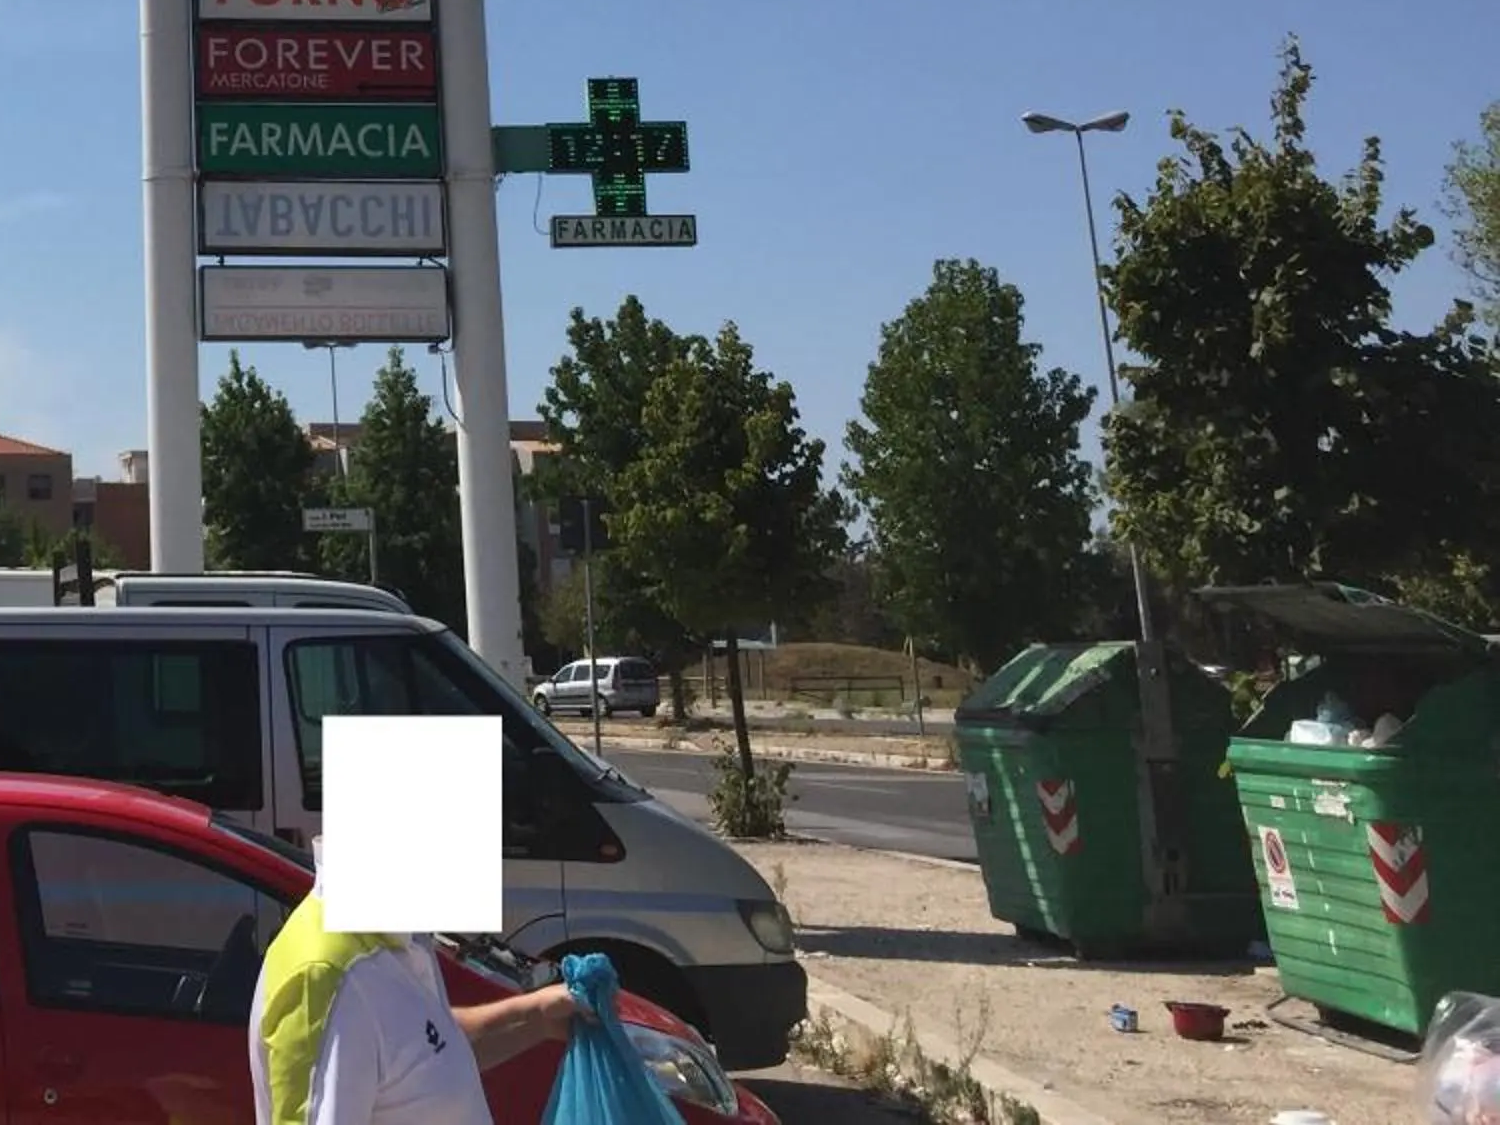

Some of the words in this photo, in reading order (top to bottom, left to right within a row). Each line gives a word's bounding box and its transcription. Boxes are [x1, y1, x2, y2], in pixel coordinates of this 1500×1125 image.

[207, 36, 426, 72] FOREVER
[210, 72, 331, 90] MERCATONE
[210, 122, 432, 159] FARMACIA
[557, 220, 693, 241] FARMACIA
